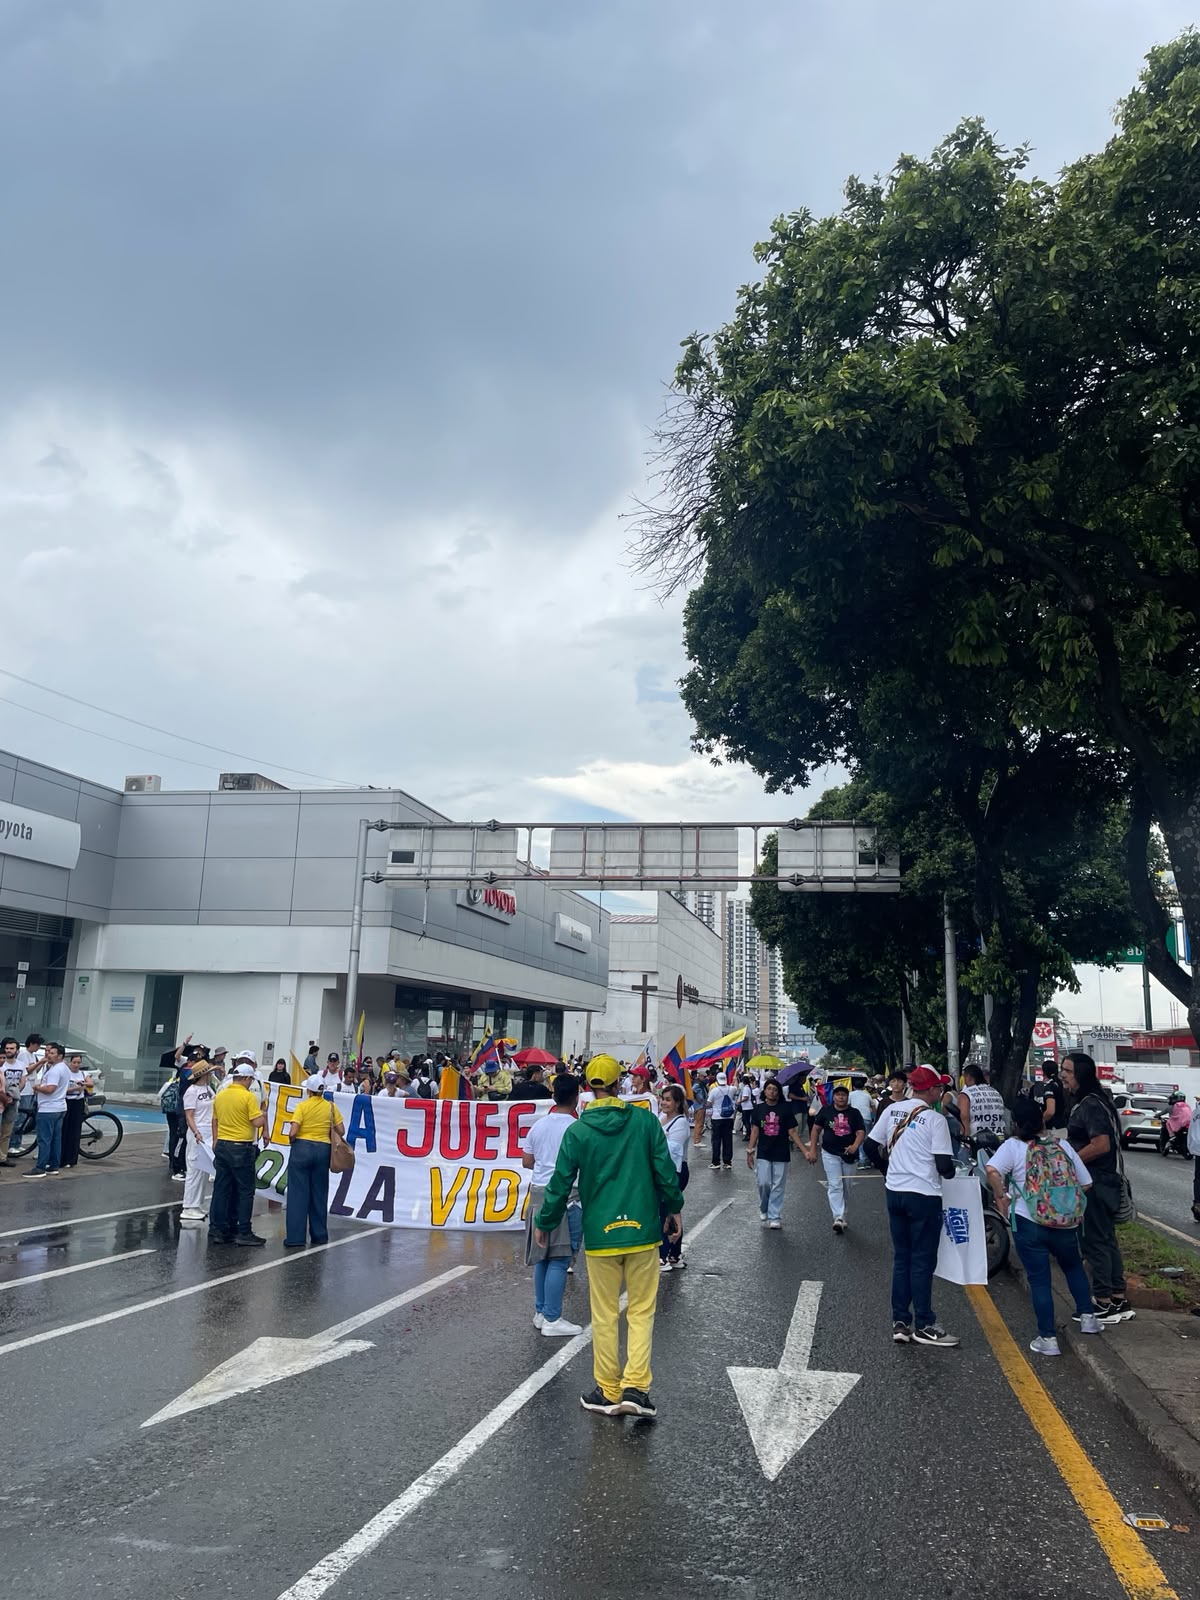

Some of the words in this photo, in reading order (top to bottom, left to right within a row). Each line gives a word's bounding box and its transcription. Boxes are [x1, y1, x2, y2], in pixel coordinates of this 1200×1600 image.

[482, 887, 516, 916] TOYOTA
[396, 1098, 558, 1160] JUEG
[430, 1166, 532, 1227] VID
[948, 1206, 968, 1245] AGUA
